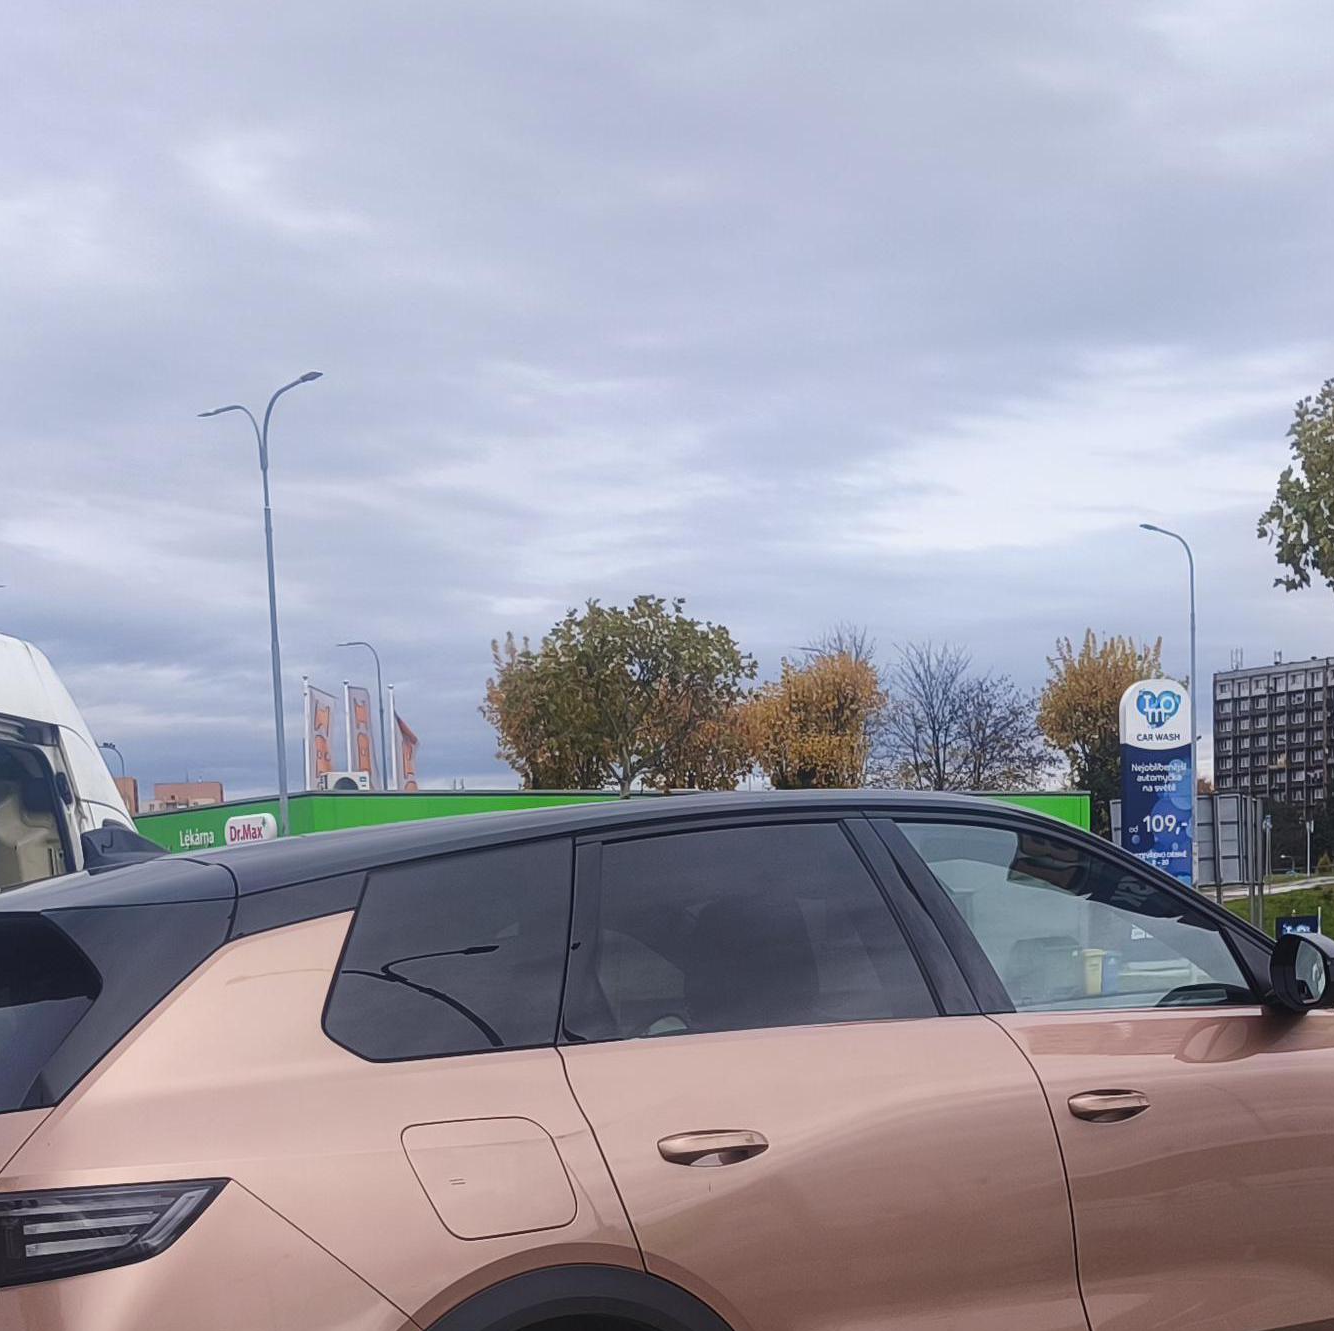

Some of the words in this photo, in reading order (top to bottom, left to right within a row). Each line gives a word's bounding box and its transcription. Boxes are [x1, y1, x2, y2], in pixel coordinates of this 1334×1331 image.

[1136, 733, 1153, 741] CAR
[1155, 733, 1181, 741] WASH
[179, 828, 215, 847] Lékárna
[229, 823, 264, 842] Dr.Max
[1128, 825, 1139, 833] od
[1142, 814, 1188, 835] 109,-
